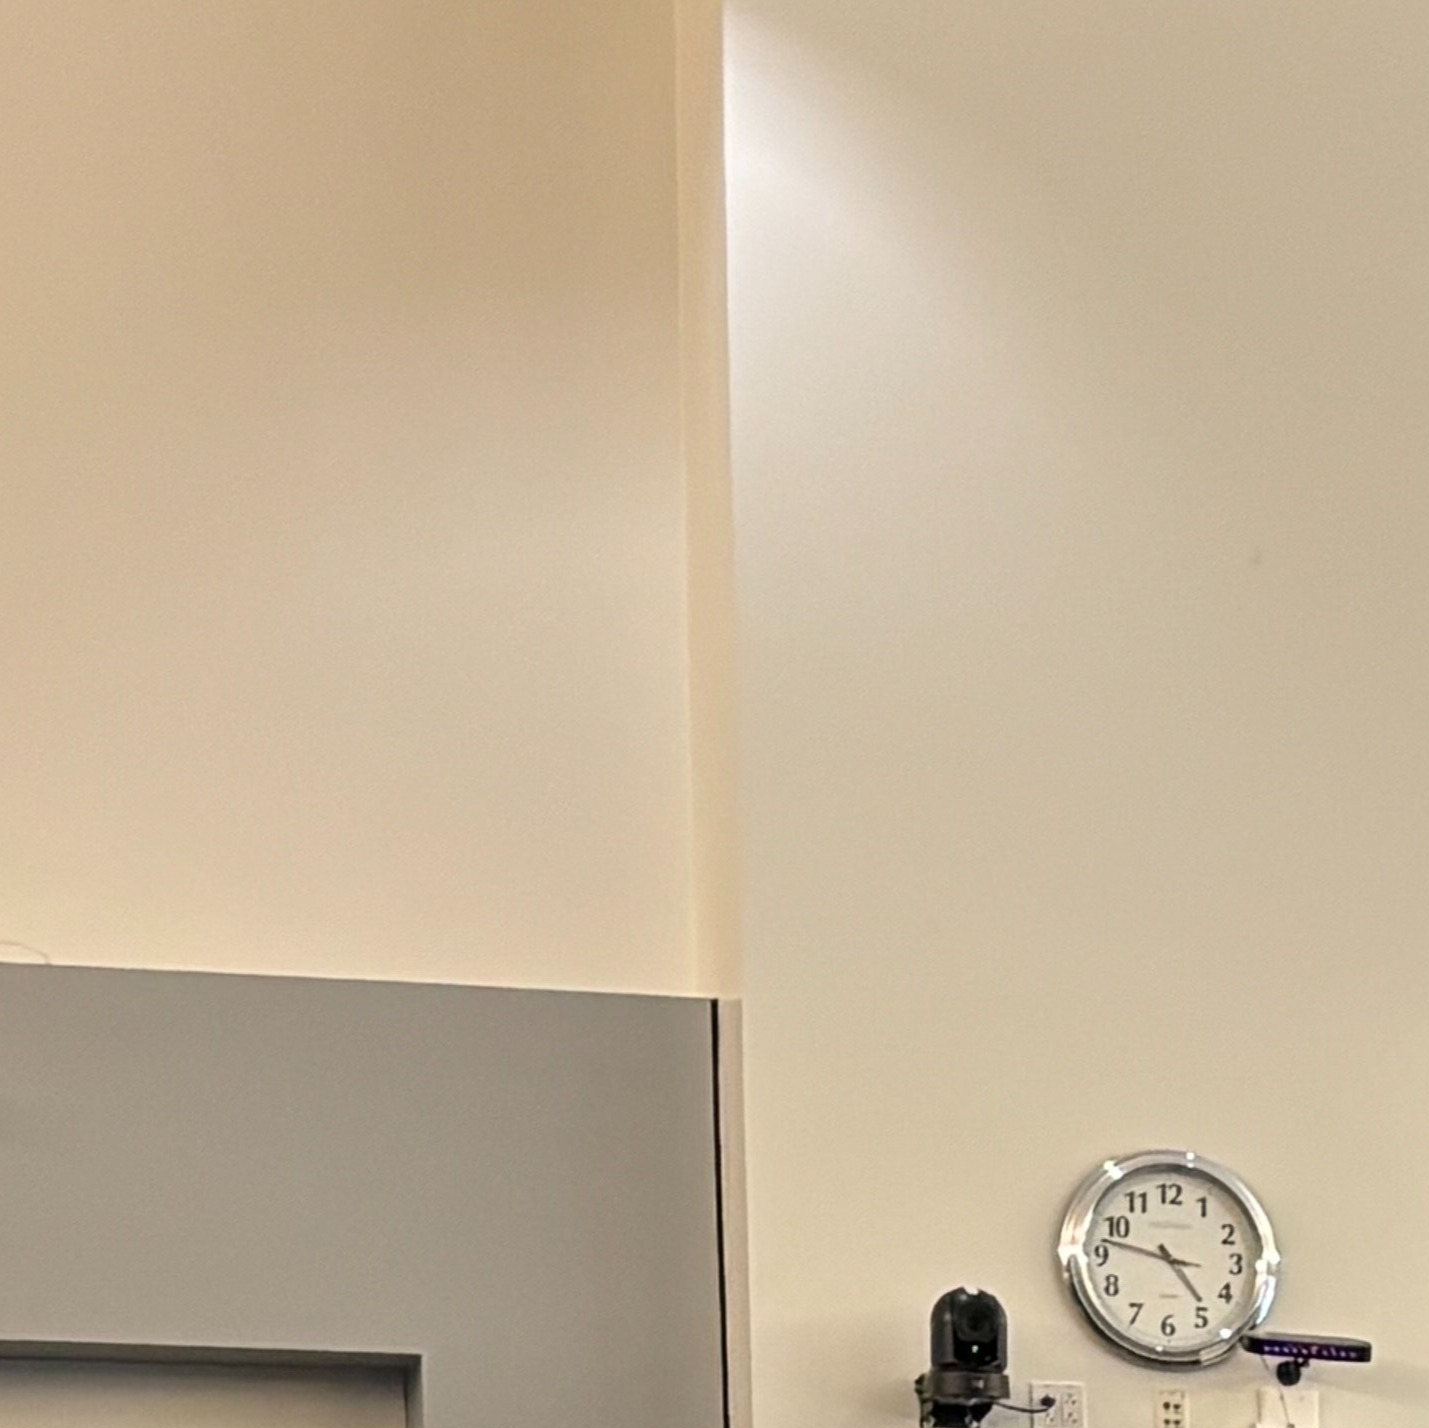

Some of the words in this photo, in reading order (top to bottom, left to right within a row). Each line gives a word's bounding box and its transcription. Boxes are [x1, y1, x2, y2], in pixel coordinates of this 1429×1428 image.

[1125, 1191, 1148, 1214] 11
[1156, 1183, 1183, 1206] 12
[1196, 1197, 1207, 1218] 1
[1104, 1215, 1130, 1238] 10
[1221, 1224, 1235, 1245] 2
[1094, 1245, 1109, 1267] 9
[1229, 1253, 1243, 1275] 3
[1104, 1274, 1119, 1296] 8
[1218, 1282, 1233, 1304] 4
[1129, 1303, 1144, 1325] 7
[1194, 1307, 1208, 1329] 5
[1161, 1315, 1176, 1336] 6
